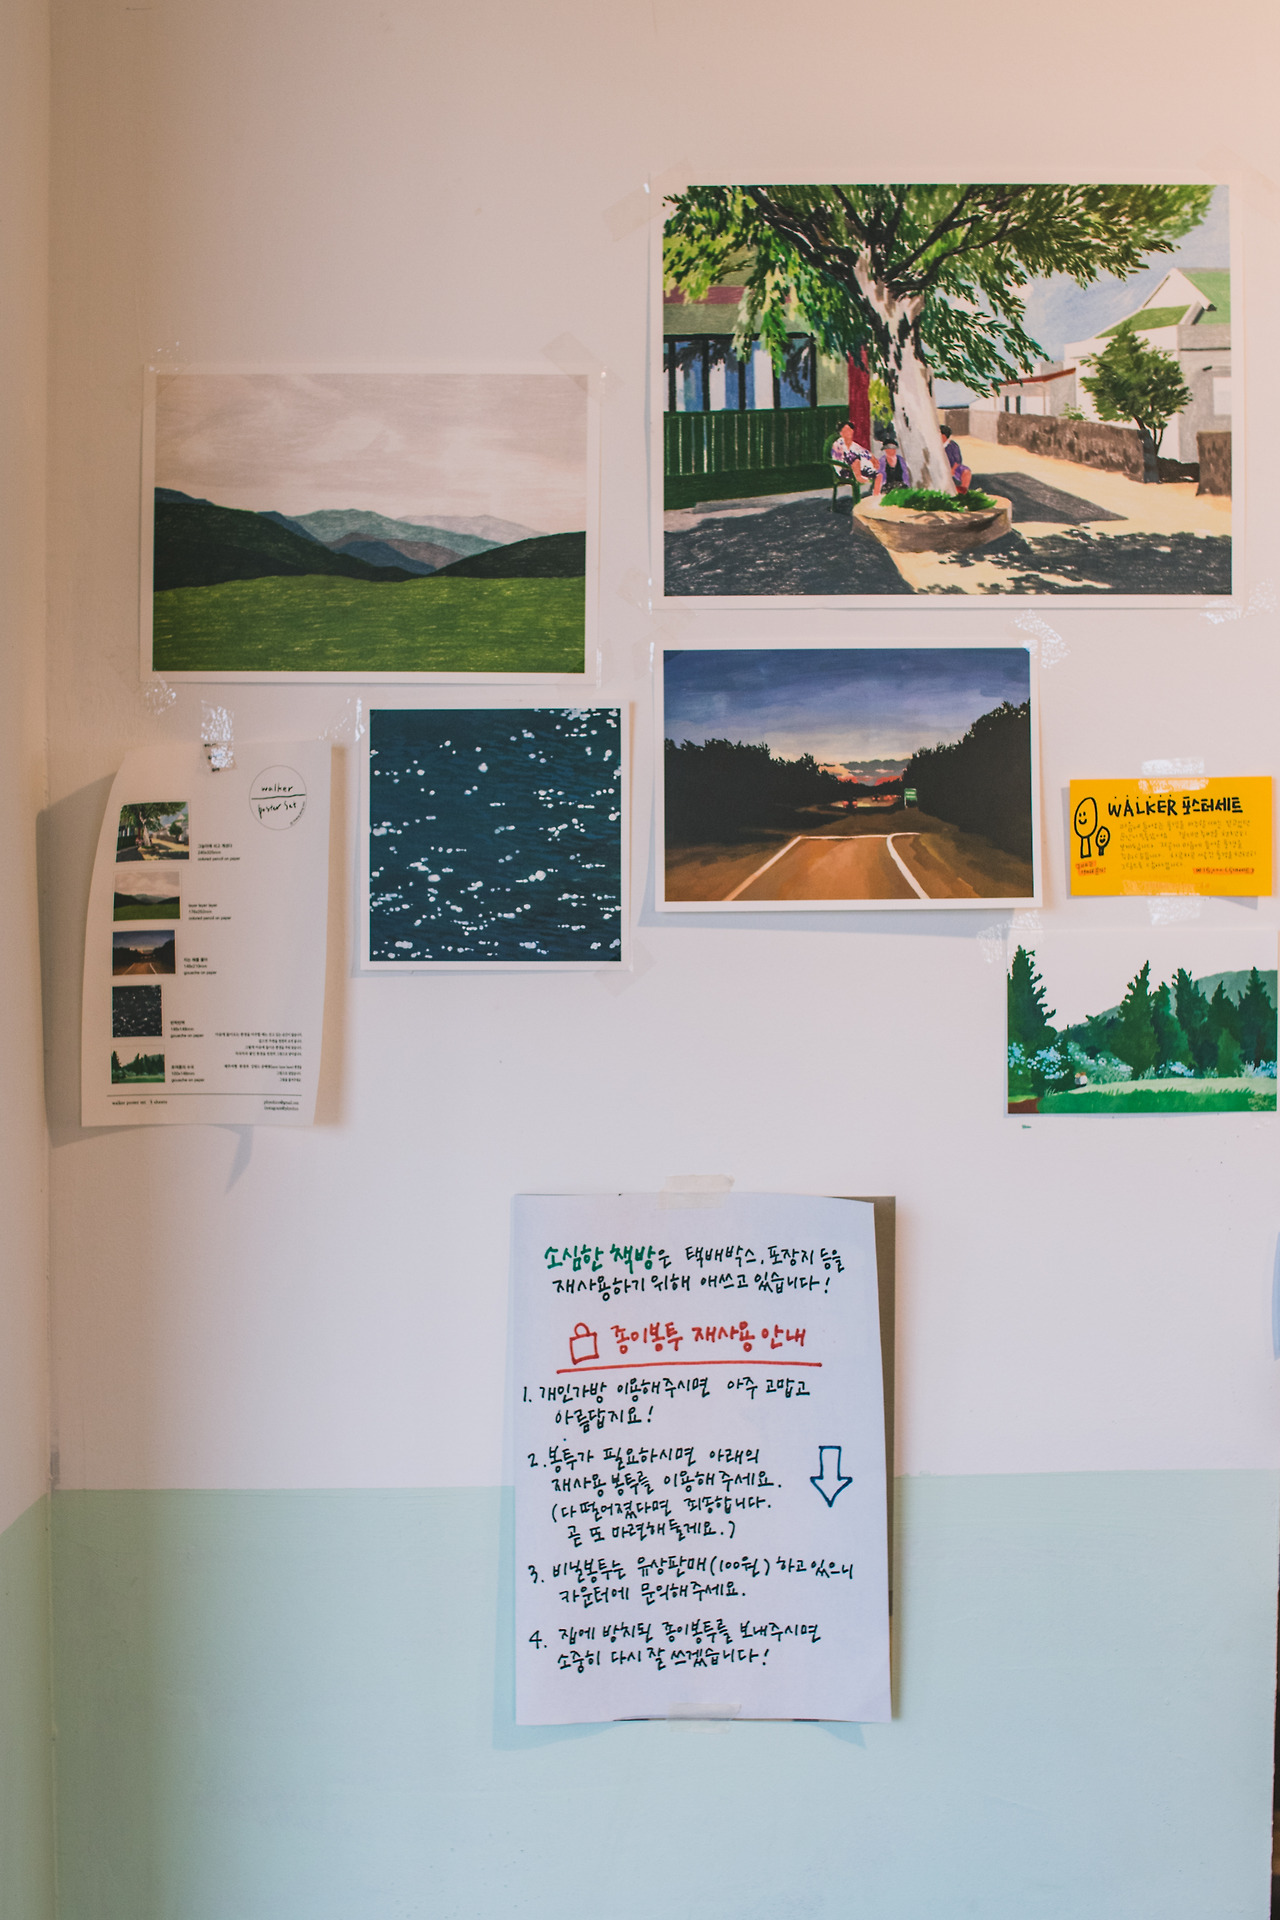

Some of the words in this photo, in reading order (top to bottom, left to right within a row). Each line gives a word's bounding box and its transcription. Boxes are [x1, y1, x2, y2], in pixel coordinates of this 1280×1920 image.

[262, 783, 293, 793] walker
[257, 803, 281, 819] poster
[1108, 797, 1178, 817] WALKER
[1182, 796, 1243, 815] 포스터세트
[544, 1244, 604, 1272] 소심한
[609, 1243, 672, 1274] 책방은
[768, 1245, 814, 1266] 포장지
[820, 1248, 845, 1273] 등을
[552, 1276, 645, 1302] 재사용하기
[651, 1273, 690, 1292] 위해
[700, 1273, 749, 1289] 애쓰고
[754, 1272, 830, 1294] 있습니다!
[610, 1322, 683, 1354] 종이봉투
[692, 1321, 755, 1352] 재사용
[761, 1324, 806, 1349] 안내
[539, 1382, 607, 1404] 개인가방
[727, 1377, 758, 1400] 아주
[766, 1378, 810, 1398] 고맙고
[555, 1406, 653, 1434] 아름답지요!
[549, 1446, 594, 1473] 봉투가
[603, 1447, 696, 1471] 필요하시면
[709, 1449, 759, 1465] 아래의
[568, 1525, 582, 1548] 곧
[589, 1526, 605, 1543] 또
[553, 1558, 626, 1584] 비닐봉투는
[559, 1586, 629, 1609] 카운터에
[558, 1627, 595, 1645] 집에
[603, 1622, 653, 1643] 방치된
[662, 1618, 733, 1645] 종이봉투를
[740, 1620, 821, 1643] 보내주시면
[557, 1650, 600, 1674] 소중히
[611, 1650, 641, 1665] 다시
[670, 1648, 769, 1668] 쓰겠습니다!
